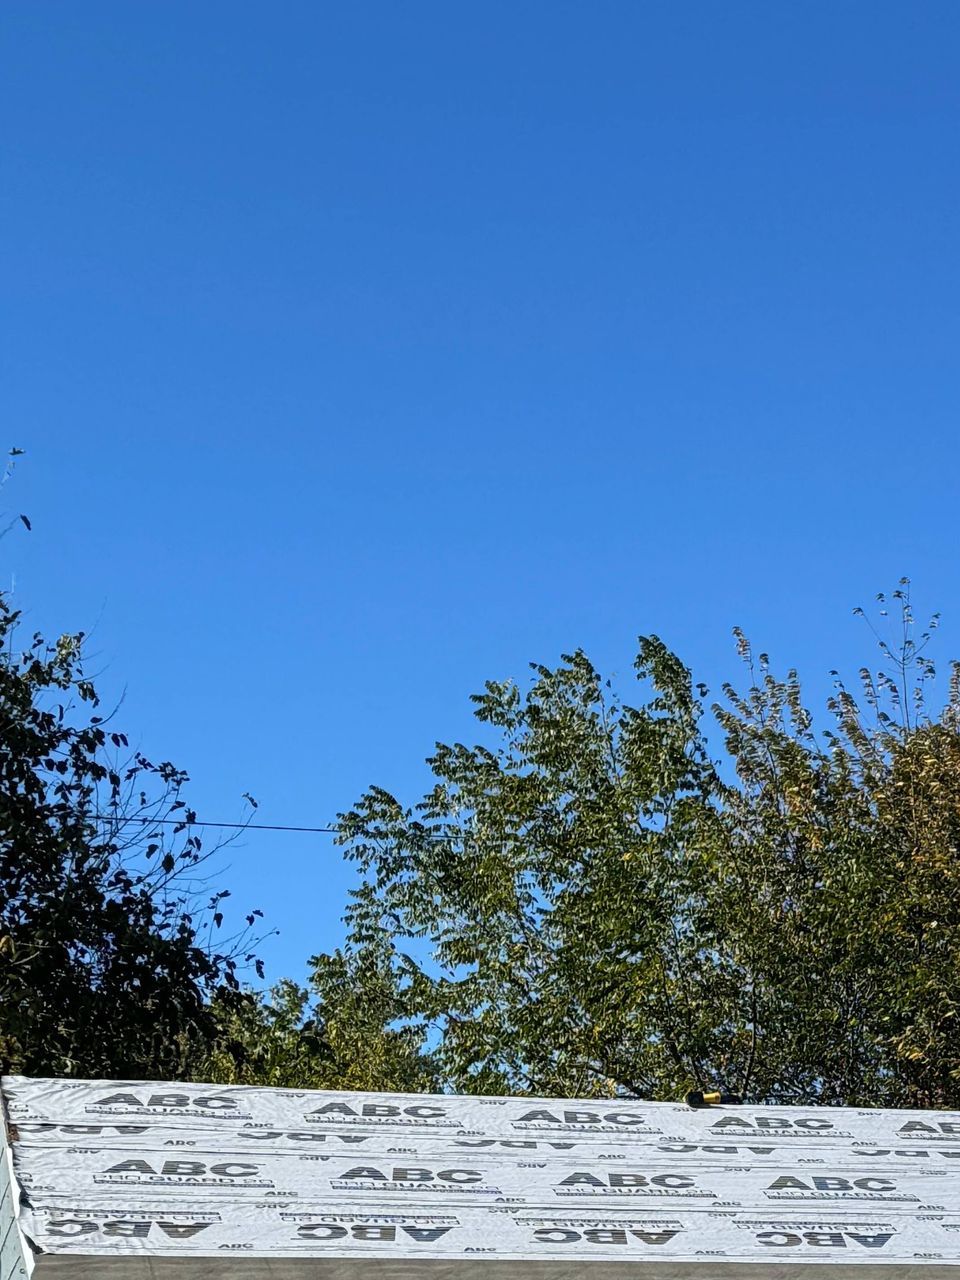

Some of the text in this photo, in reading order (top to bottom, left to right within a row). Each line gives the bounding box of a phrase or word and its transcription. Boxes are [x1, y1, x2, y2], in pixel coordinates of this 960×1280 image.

[92, 1093, 238, 1109] ABC
[308, 1102, 447, 1118] ABC
[517, 1109, 645, 1126] ABC
[711, 1116, 834, 1130] ABC
[102, 1160, 259, 1177] ABC
[338, 1166, 483, 1183] ABC
[558, 1172, 695, 1189] ABC
[766, 1175, 897, 1191] ABC
[45, 1220, 213, 1238] ABC
[297, 1223, 454, 1242] ABC
[533, 1228, 681, 1245] ABC
[755, 1231, 894, 1248] ABC
